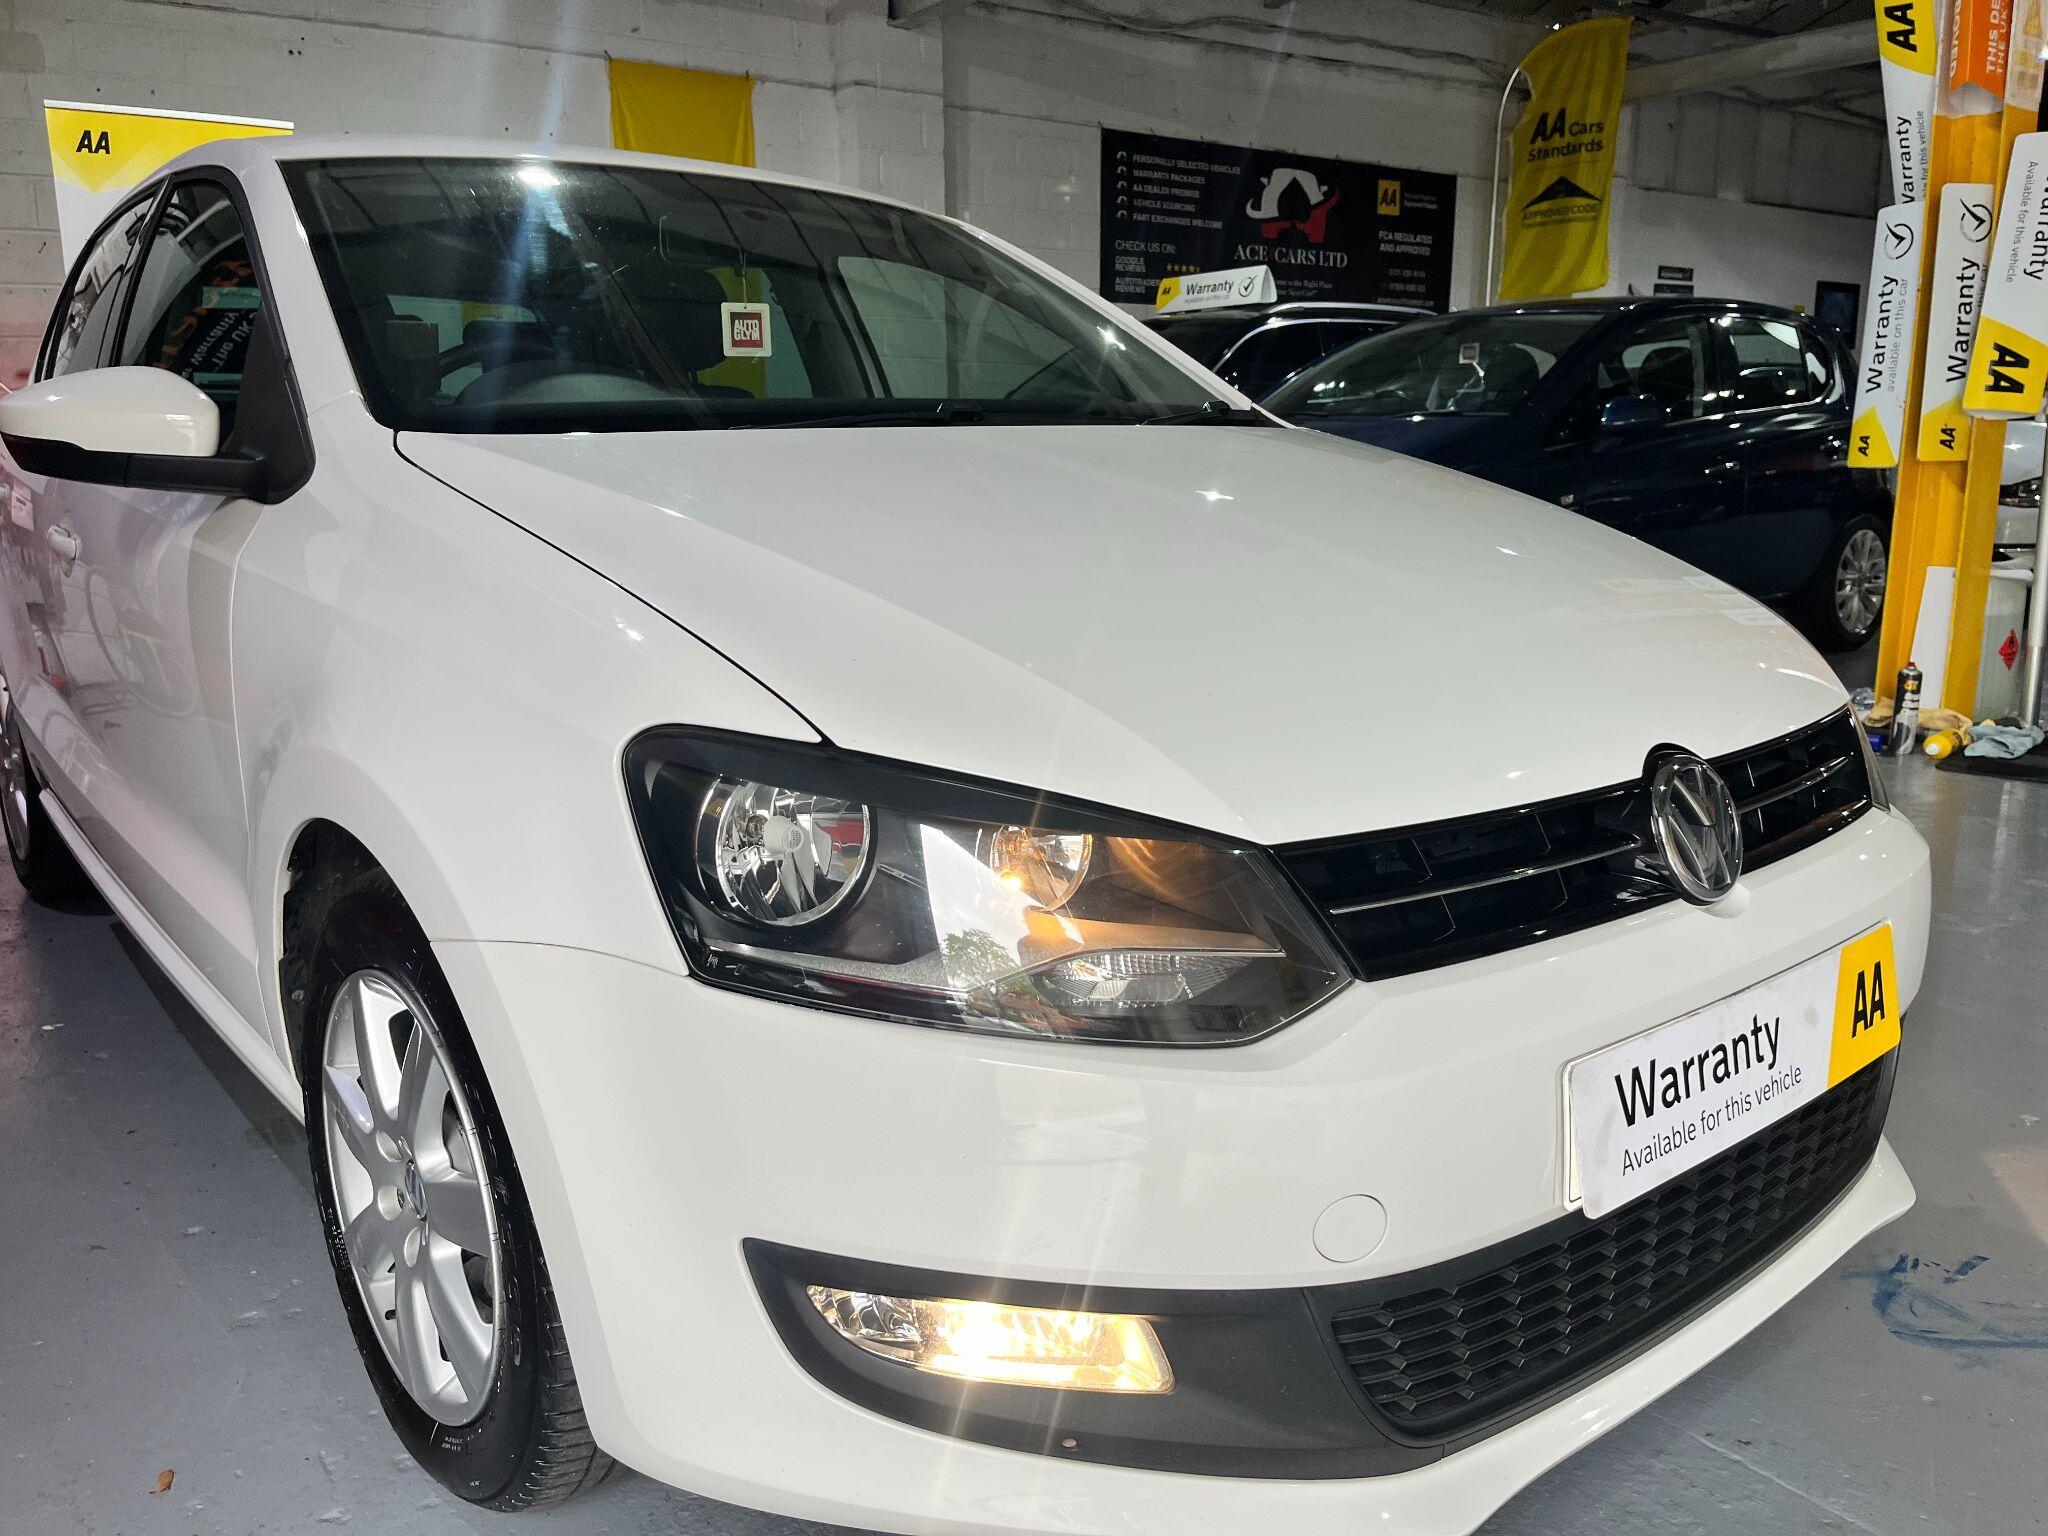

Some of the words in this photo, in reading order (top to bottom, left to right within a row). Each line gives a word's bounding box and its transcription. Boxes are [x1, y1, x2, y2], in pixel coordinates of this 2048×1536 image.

[1884, 2, 1917, 53] AA
[1986, 29, 1999, 73] THIS
[1997, 41, 2006, 74] THE
[1530, 107, 1566, 145] AA
[1568, 121, 1605, 137] Cars
[1916, 111, 1926, 144] vehicle
[76, 130, 111, 155] AA
[1528, 138, 1604, 162] Standards
[2020, 160, 2038, 206] Available
[1379, 187, 1398, 207] AA
[2018, 206, 2029, 227] for
[1114, 240, 1146, 251] CHECK
[1147, 242, 1160, 253] US
[2013, 225, 2024, 245] this
[1233, 244, 1268, 261] ACE
[1274, 247, 1317, 265] CARS
[1319, 250, 1349, 268] LTD
[2006, 245, 2020, 283] vehicle
[1186, 280, 1235, 296] Warranty
[1899, 279, 1908, 297] car
[1895, 299, 1906, 321] this
[1946, 257, 1980, 382] Warranty
[734, 320, 760, 331] AUTO
[734, 330, 760, 340] GLYM
[1863, 275, 1898, 394] Warranty
[1894, 323, 1903, 338] on
[1887, 341, 1901, 393] available
[1984, 341, 2031, 394] AA
[1858, 435, 1871, 456] AA
[1939, 426, 1957, 451] AA
[1851, 960, 1885, 1039] AA
[1614, 1014, 1780, 1127] Warranty
[1622, 1120, 1697, 1176] Available
[1700, 1108, 1721, 1139] for
[1725, 1091, 1752, 1122] this
[1754, 1065, 1802, 1107] vehicle
